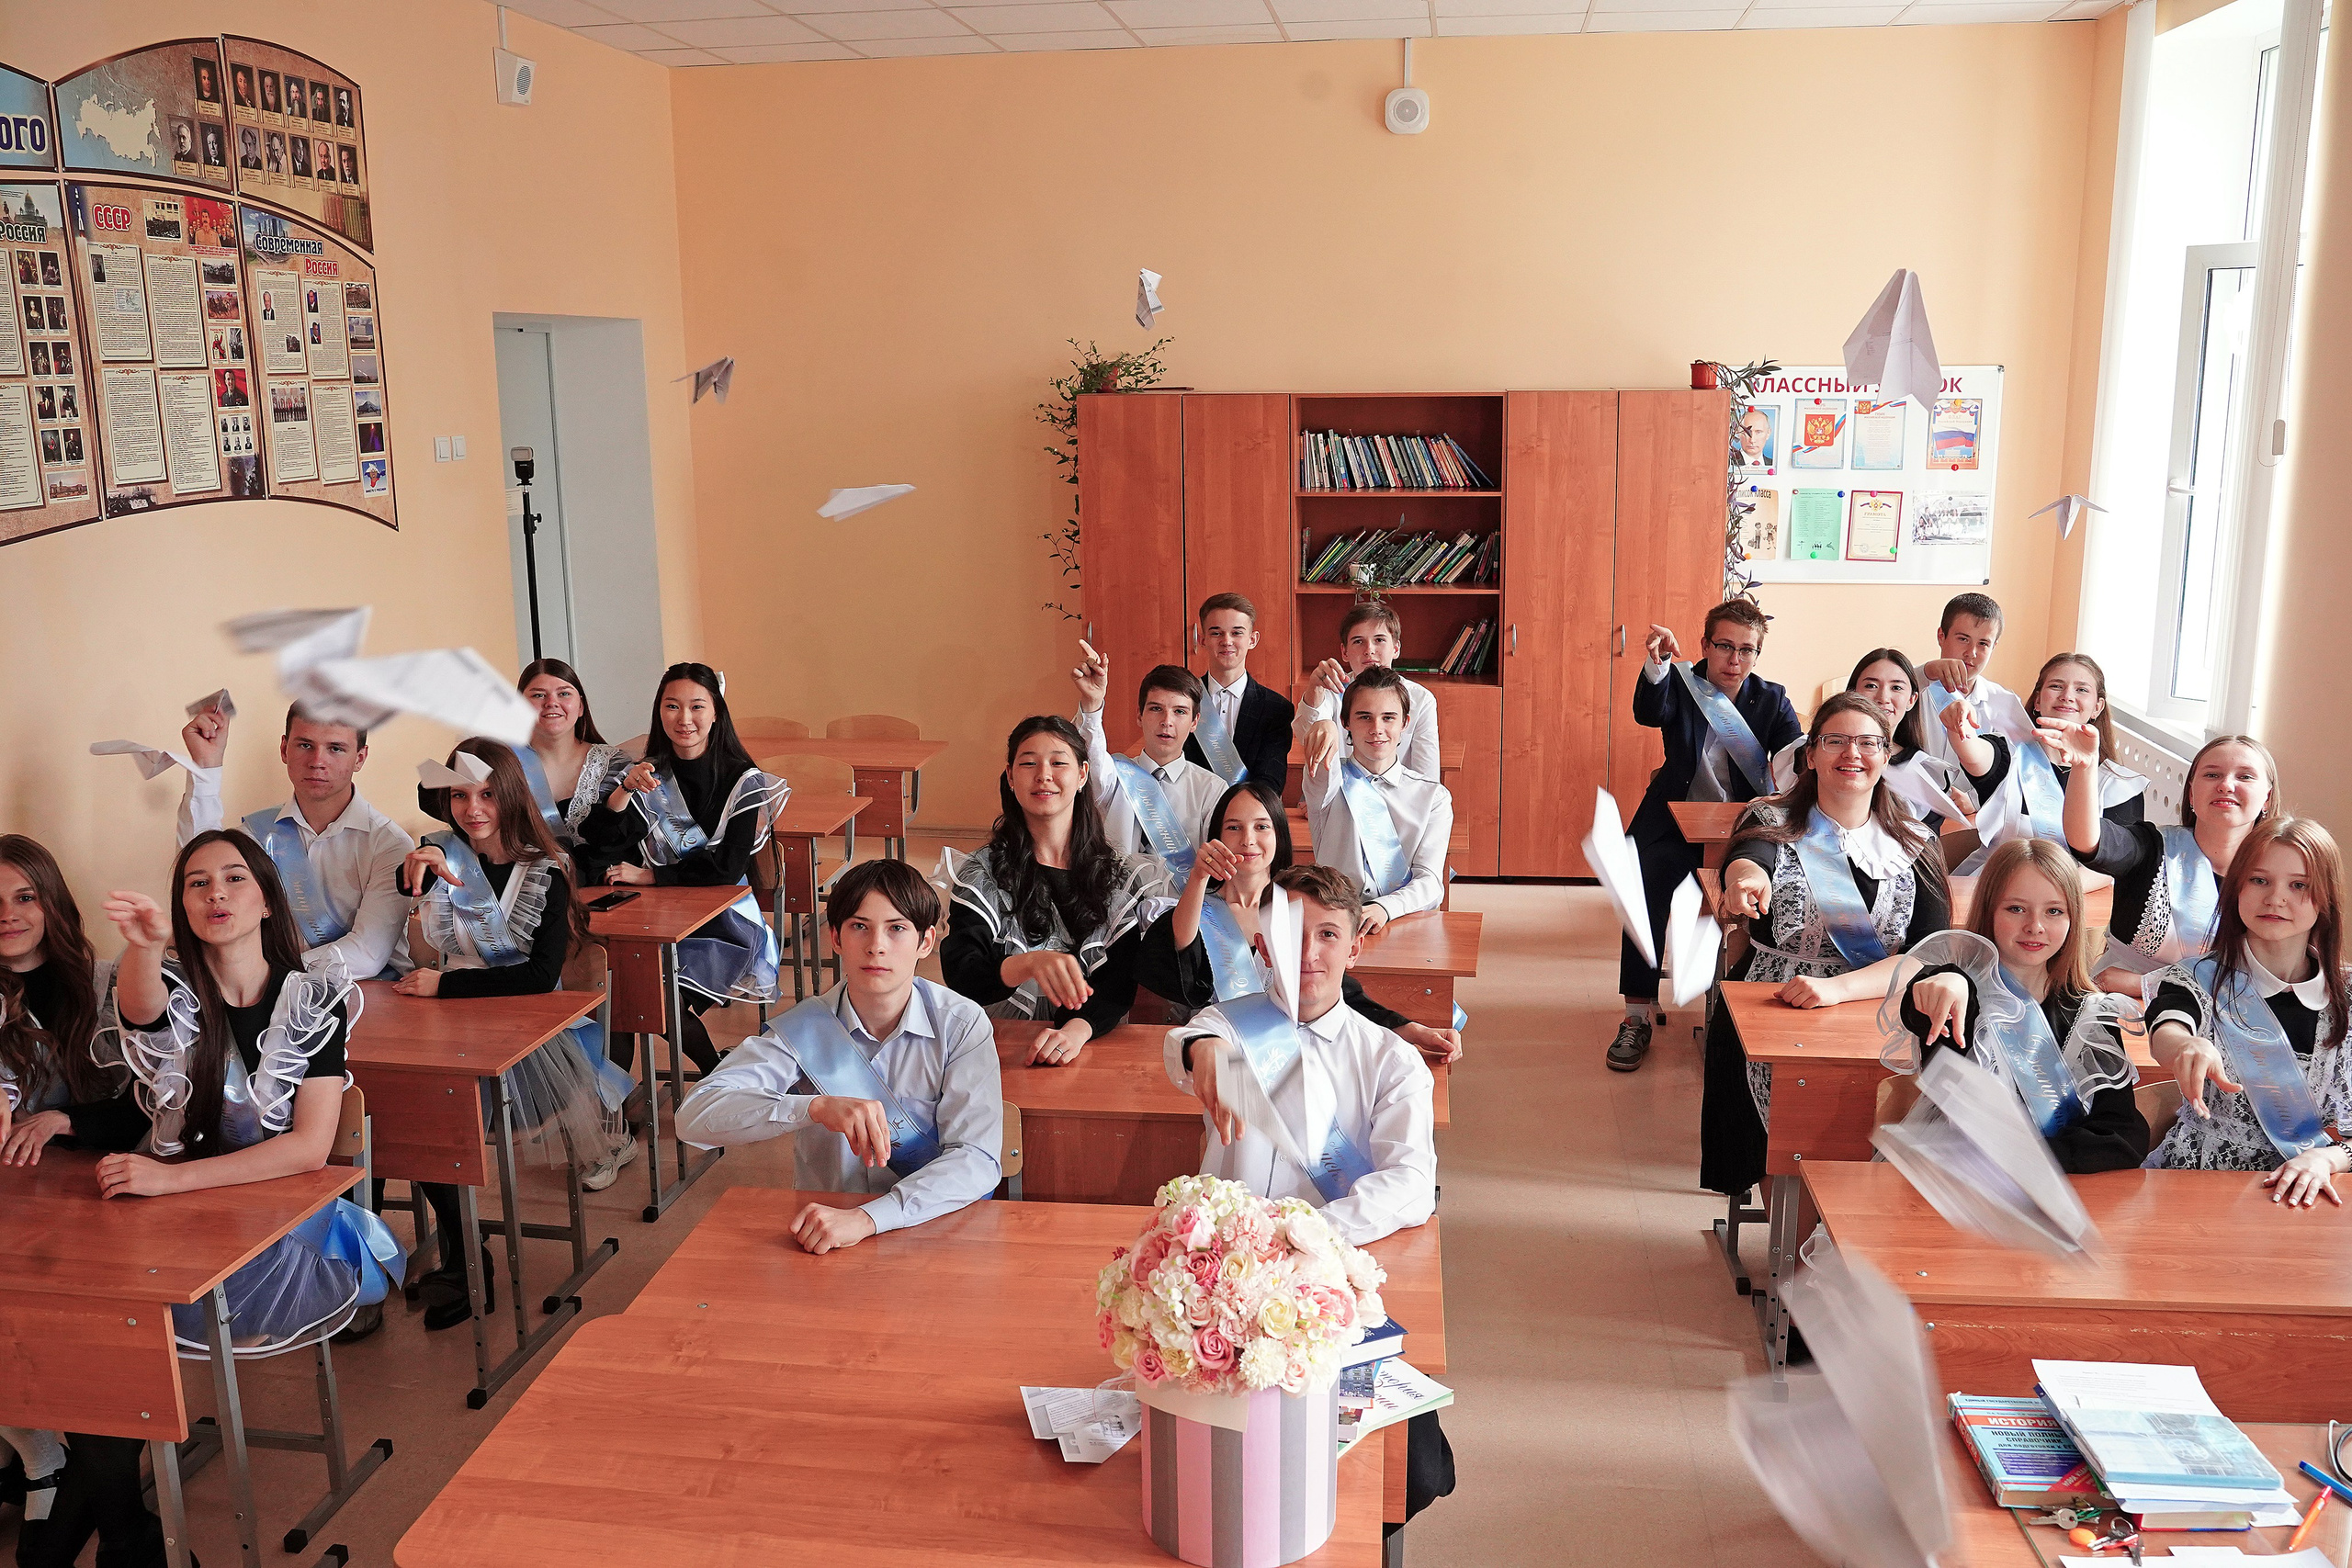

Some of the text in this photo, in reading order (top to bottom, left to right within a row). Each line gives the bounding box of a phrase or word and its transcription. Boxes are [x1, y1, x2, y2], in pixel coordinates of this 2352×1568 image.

[93, 204, 132, 231] СССР
[254, 232, 323, 255] Современная
[1986, 1416, 2059, 1427] ИСТОРИЯ
[2006, 1437, 2064, 1445] СПРАВОЧНИК
